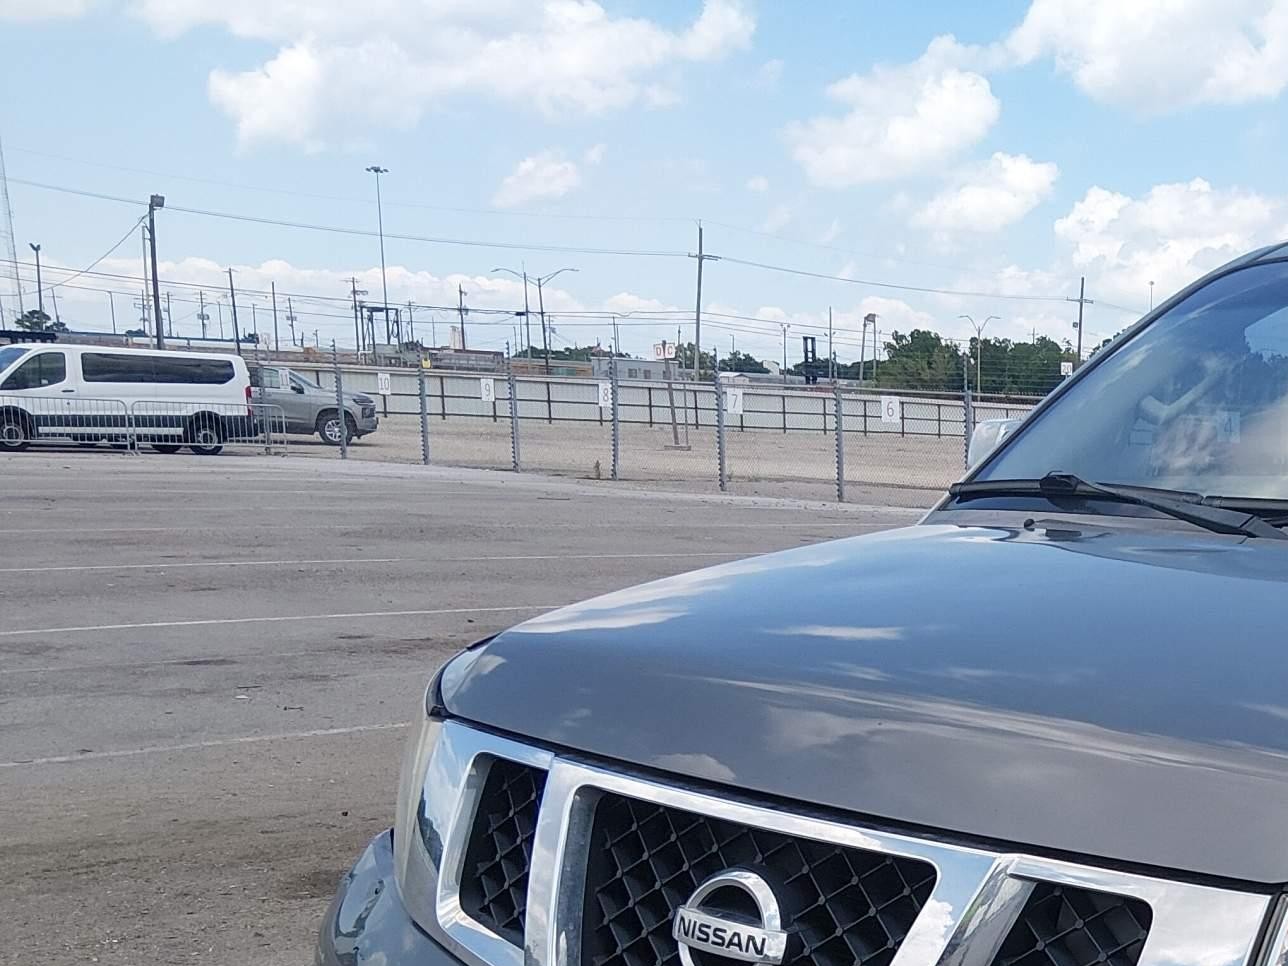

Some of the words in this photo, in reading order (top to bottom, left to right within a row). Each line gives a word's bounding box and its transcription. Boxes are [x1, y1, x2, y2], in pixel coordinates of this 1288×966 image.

[667, 345, 673, 355] C
[380, 376, 389, 390] 10
[484, 383, 490, 397] 9
[603, 387, 609, 402] 8
[731, 393, 738, 408] 7
[886, 401, 895, 417] 6
[1224, 415, 1233, 432] 4
[678, 915, 766, 956] NISSAN
